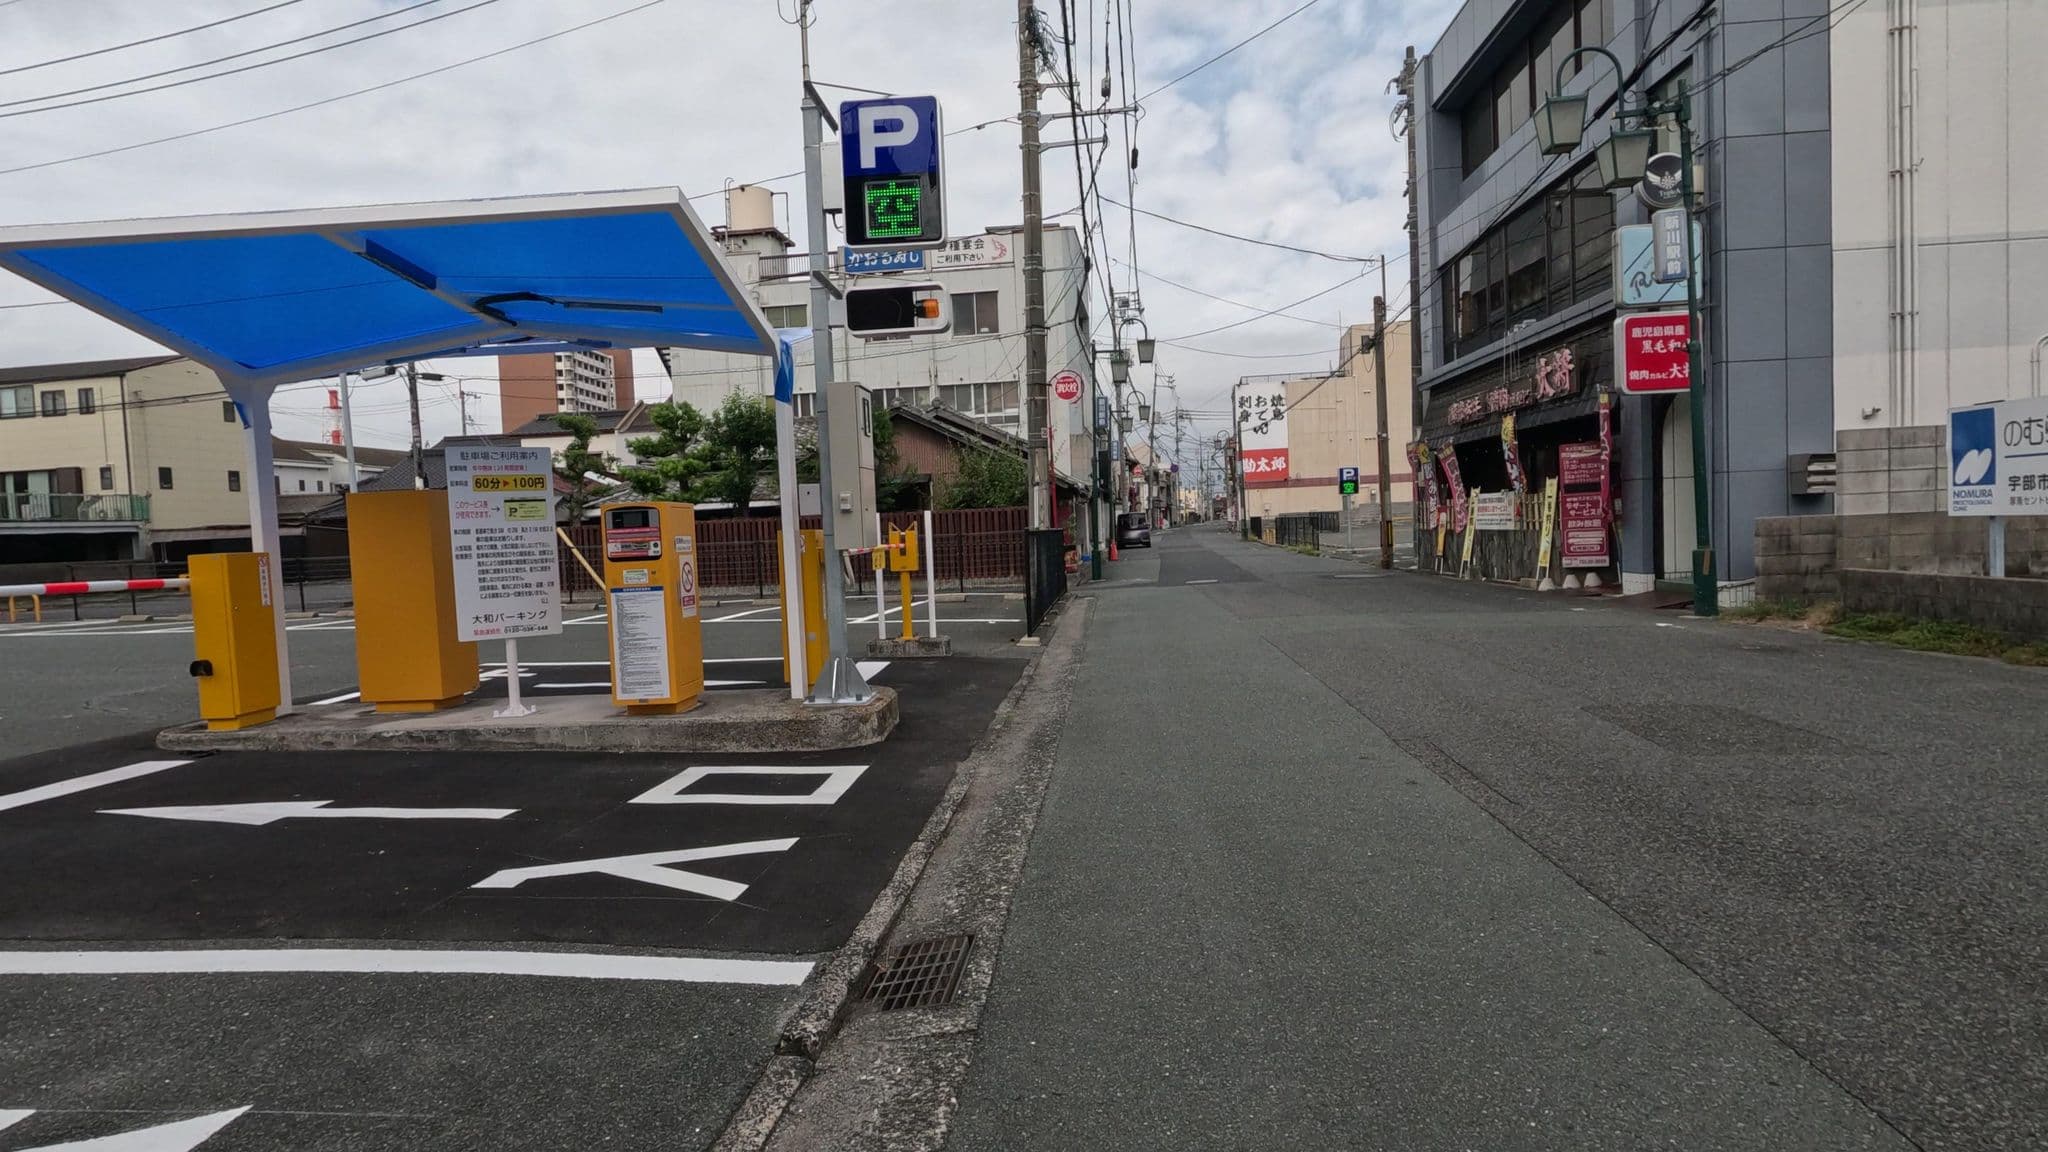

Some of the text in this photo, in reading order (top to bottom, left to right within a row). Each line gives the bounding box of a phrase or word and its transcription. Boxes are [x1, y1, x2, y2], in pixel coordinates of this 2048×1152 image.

[858, 105, 920, 169] P
[866, 181, 921, 236] 空
[1632, 325, 1685, 338] 鹿児島県産
[2003, 415, 2048, 447] のむ
[1342, 468, 1355, 480] P
[2008, 473, 2048, 491] 宇部市
[474, 476, 545, 490] 60分 100円
[1953, 489, 1993, 499] NOMURA
[472, 609, 548, 625] 大和パーキング
